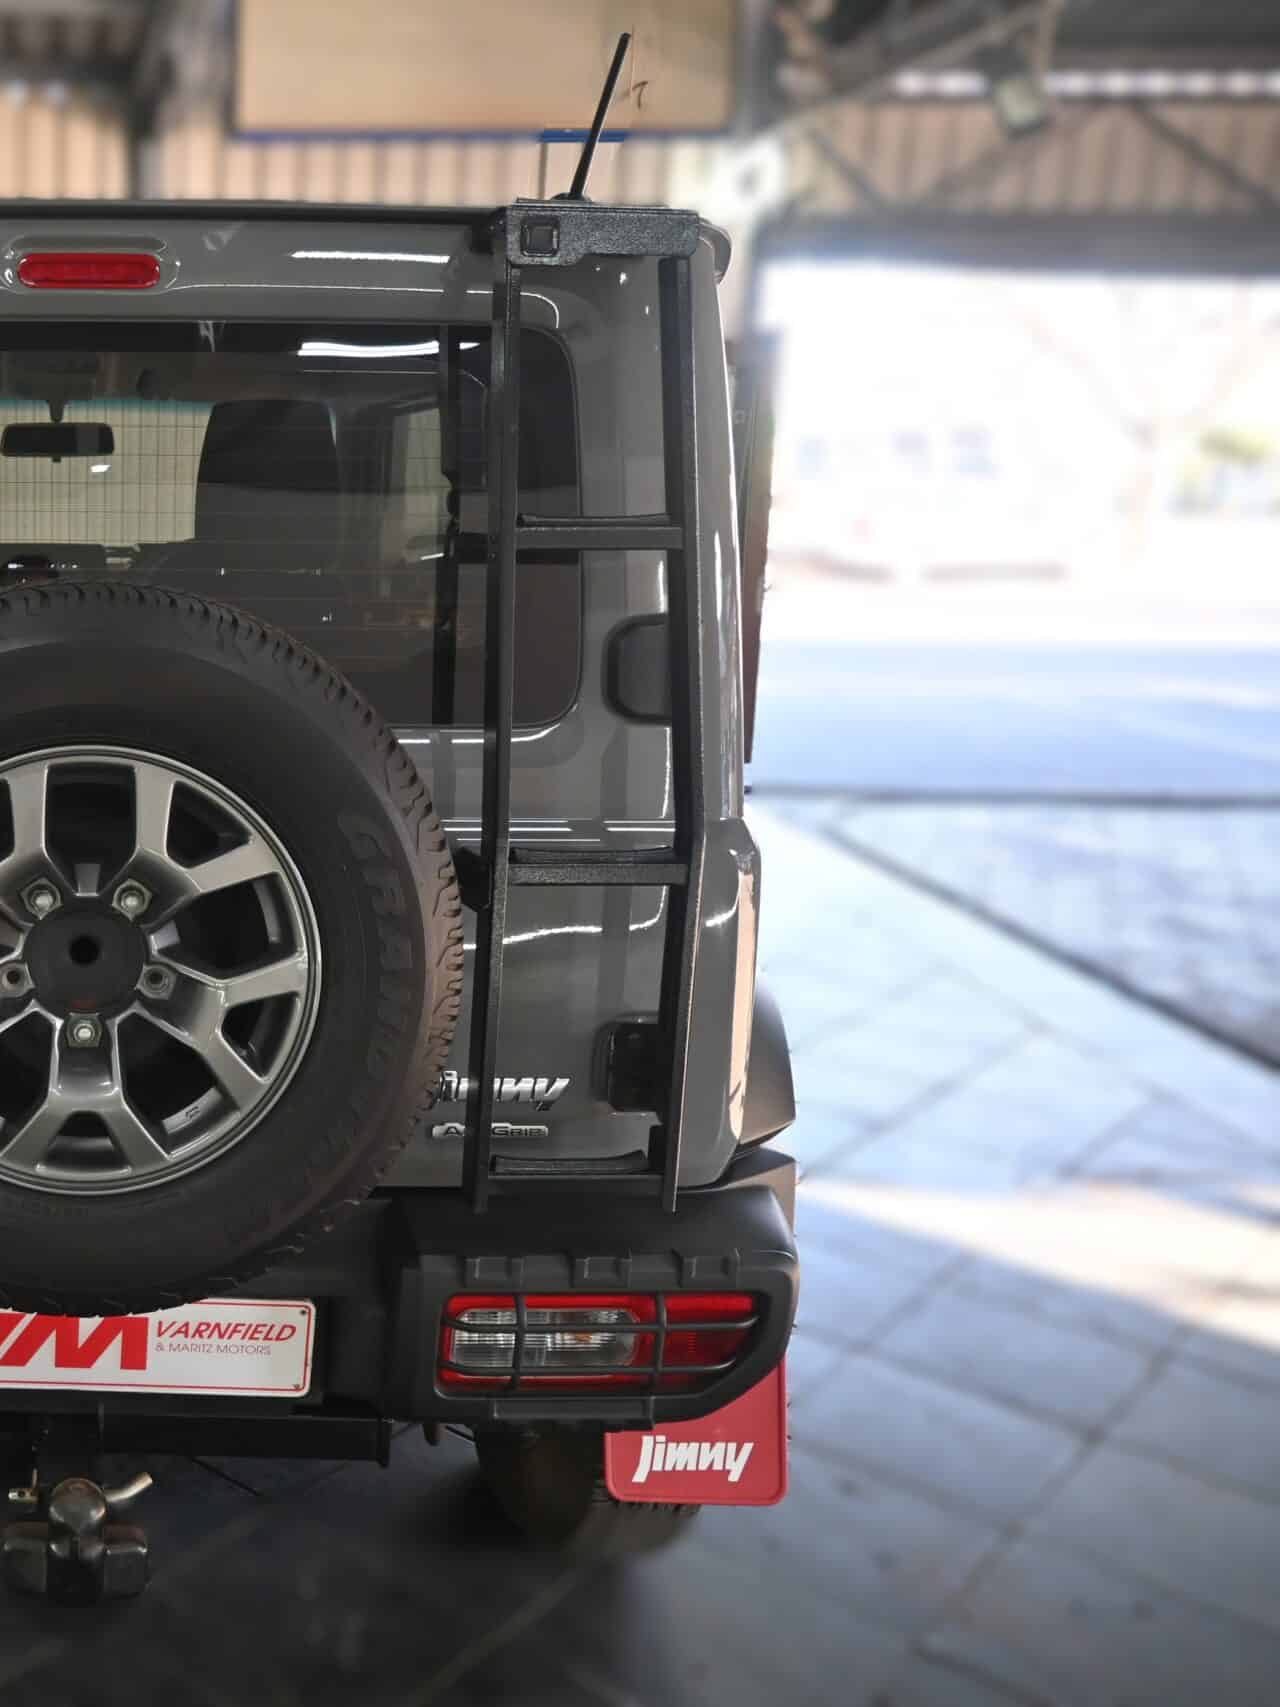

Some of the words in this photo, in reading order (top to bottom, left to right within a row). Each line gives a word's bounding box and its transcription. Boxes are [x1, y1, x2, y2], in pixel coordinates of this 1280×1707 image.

[156, 1320, 297, 1342] VARNFIELD
[168, 1343, 214, 1354] MARITZ
[216, 1344, 272, 1356] MOTORS
[631, 1434, 755, 1483] Jimny
